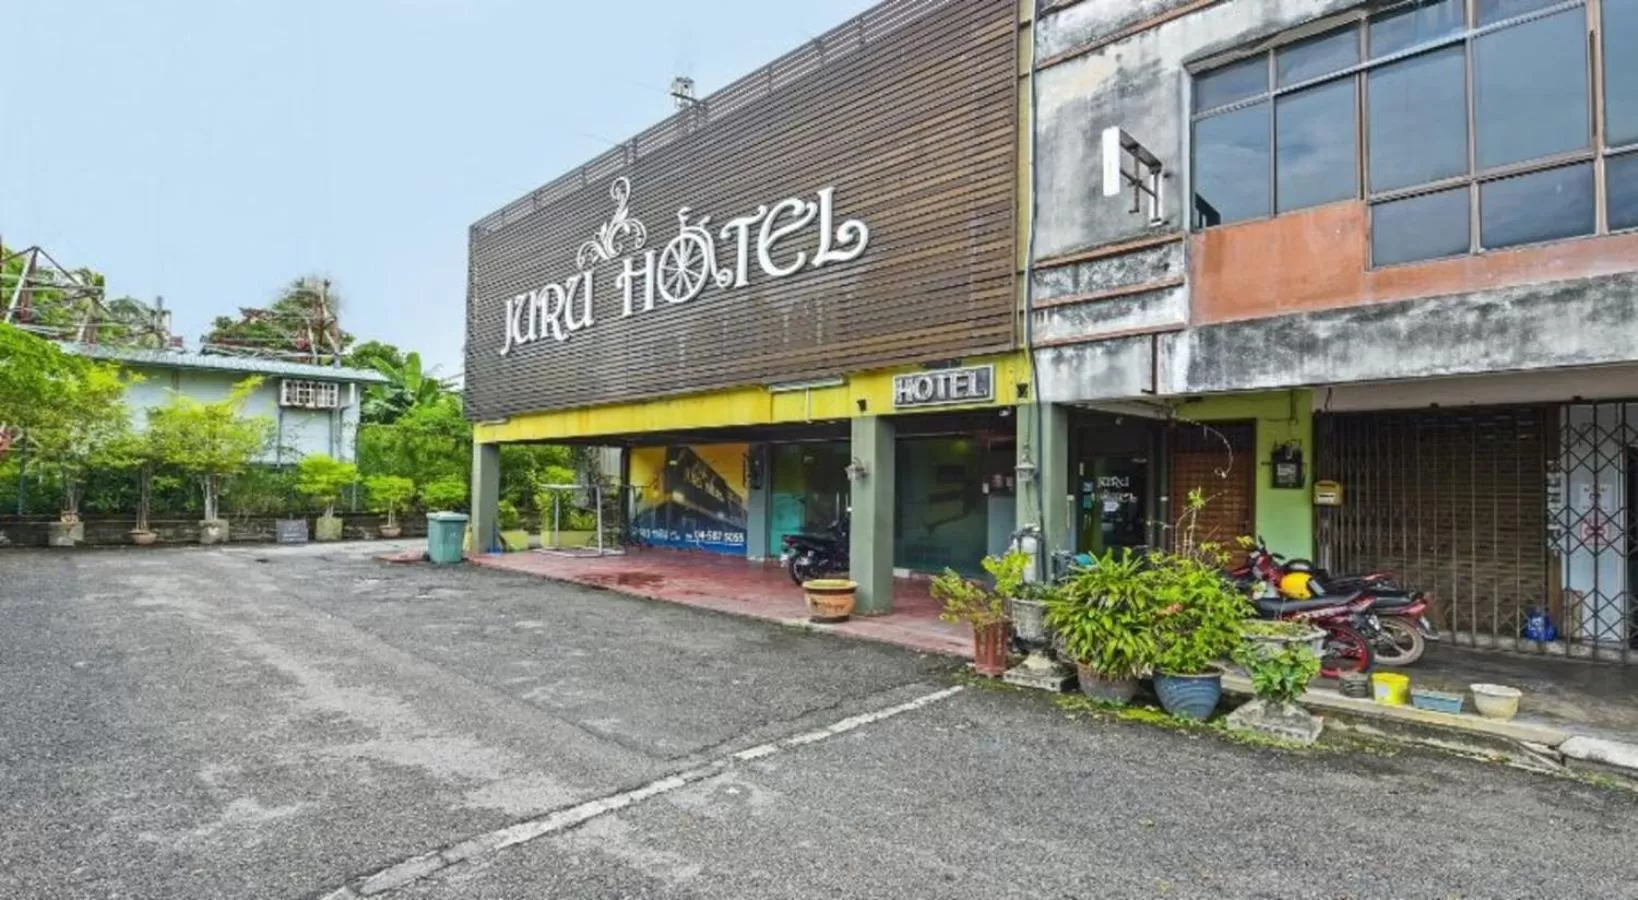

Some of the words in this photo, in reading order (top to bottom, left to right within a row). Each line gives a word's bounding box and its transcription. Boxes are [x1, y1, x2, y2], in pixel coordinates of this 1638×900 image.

[500, 269, 595, 356] JURU
[617, 186, 869, 317] HOTEL
[896, 370, 988, 403] HOTEL
